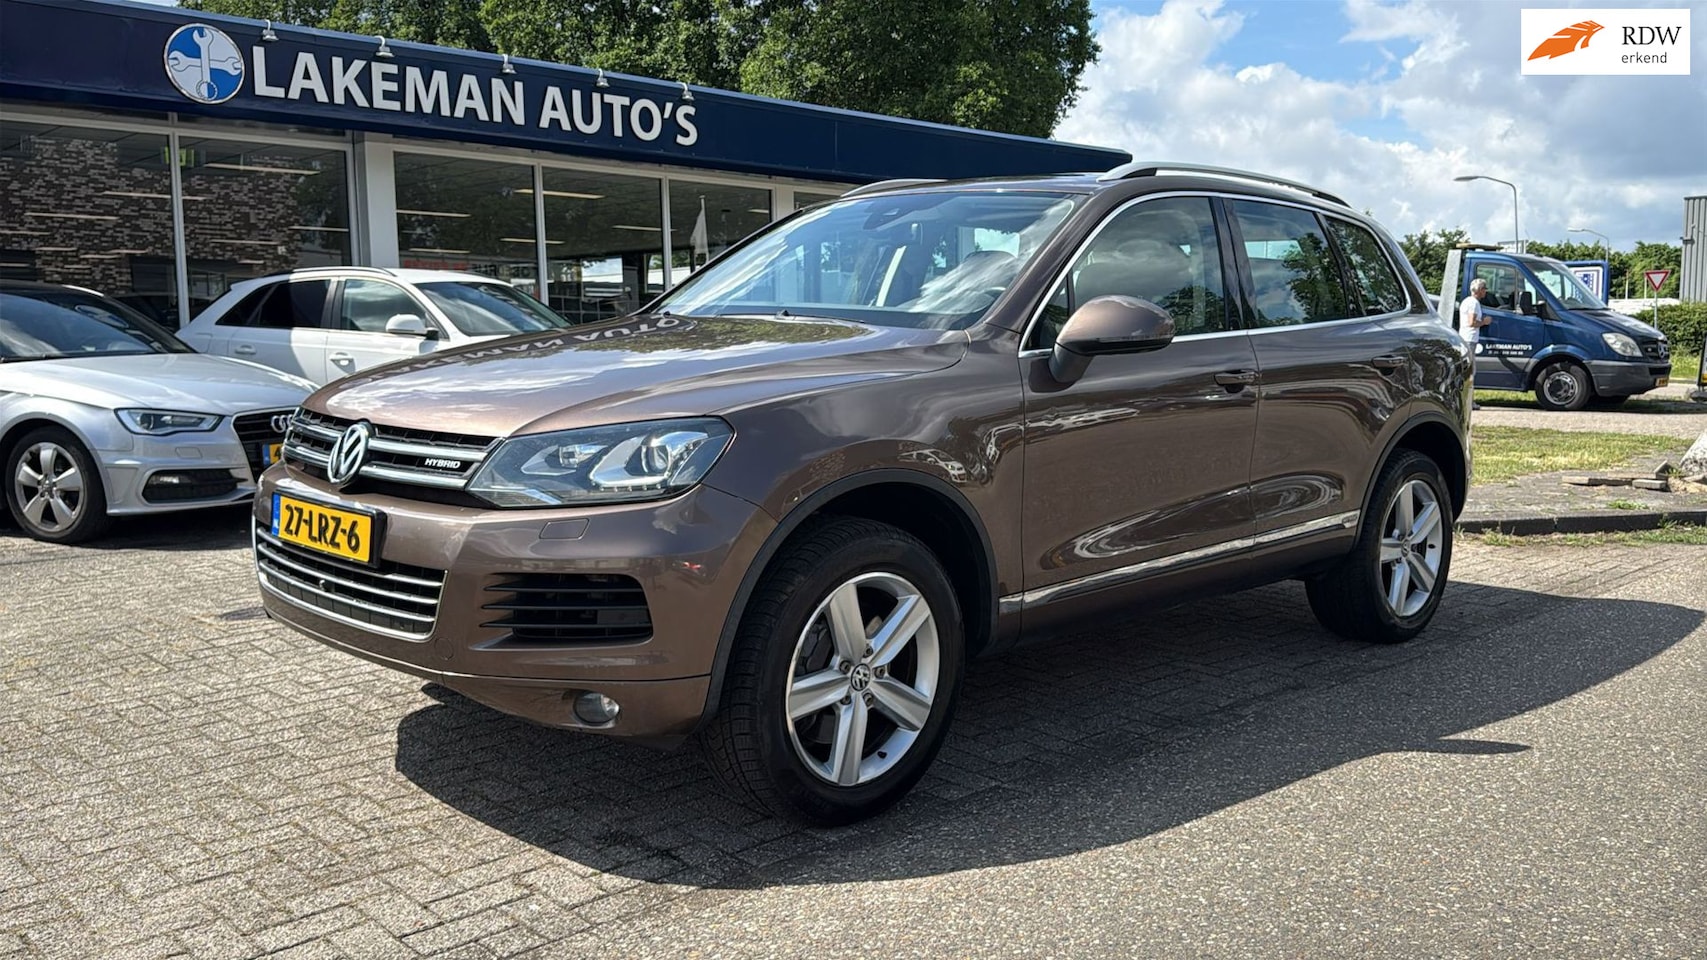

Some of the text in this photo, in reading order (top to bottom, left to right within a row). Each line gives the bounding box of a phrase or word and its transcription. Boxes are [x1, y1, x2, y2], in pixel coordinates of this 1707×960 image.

[252, 45, 700, 147] LAKEMAN AUTO'S
[424, 457, 461, 469] HYBRID
[283, 503, 361, 554] 27-LRZ-6
